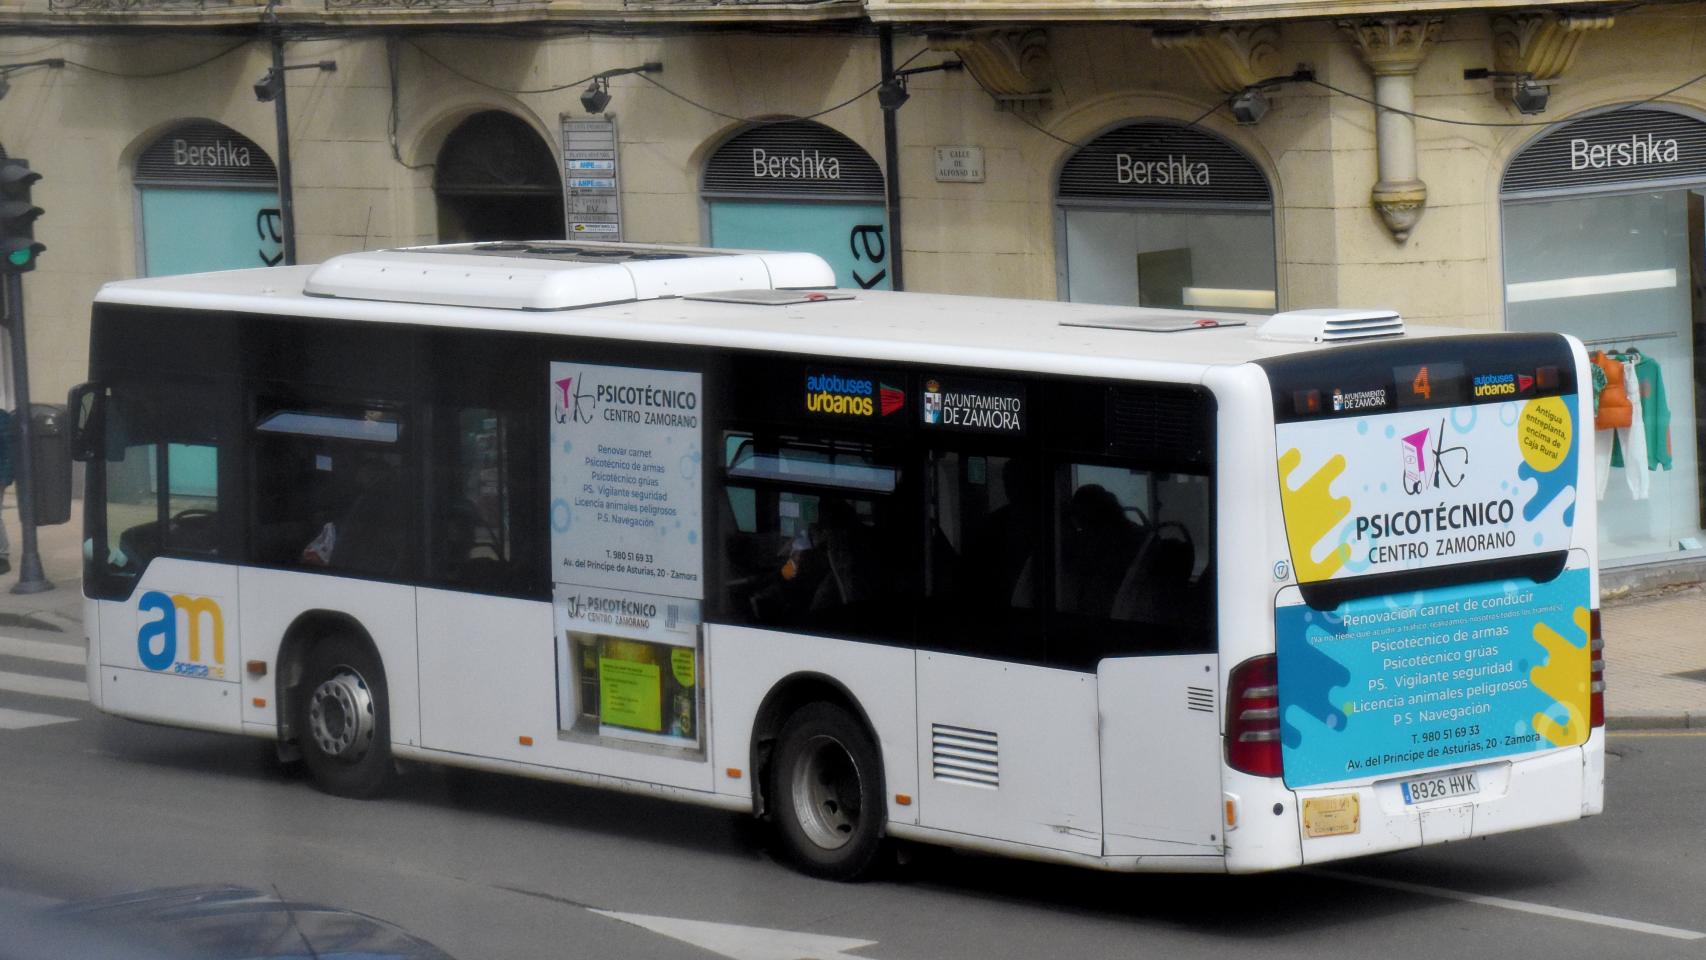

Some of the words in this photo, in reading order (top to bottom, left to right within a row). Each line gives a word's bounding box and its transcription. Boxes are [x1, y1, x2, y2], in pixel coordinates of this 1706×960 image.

[174, 139, 250, 167] Bershka
[1571, 133, 1679, 172] Bershka
[753, 148, 840, 180] Bershka
[1117, 153, 1211, 187] Bershka
[807, 374, 872, 395] autobuses
[1413, 367, 1431, 400] 4
[1474, 373, 1514, 385] autobuses
[1475, 382, 1515, 397] urbanos
[597, 384, 697, 410] PSICOTÉCNICO
[807, 391, 873, 416] urbanos
[943, 392, 1021, 412] AYUNTAMIENTO
[1344, 389, 1385, 401] AYUNTAMIENTO
[1344, 400, 1353, 409] DE
[1355, 396, 1386, 408] ZAMORA
[603, 408, 641, 424] CENTRO
[644, 411, 697, 429] ZAMORANO
[943, 407, 959, 424] DE
[962, 408, 1021, 430] ZAMORA
[1536, 405, 1563, 425] Antigua
[1524, 436, 1539, 451] Caja
[1540, 444, 1559, 459] Rural
[1526, 427, 1551, 443] encima
[1552, 438, 1561, 449] de
[597, 444, 627, 456] Renovar
[628, 448, 652, 458] carnet
[631, 461, 641, 470] de
[642, 464, 665, 473] armas
[598, 485, 630, 497] Vigilante
[631, 490, 668, 502] seguridad
[574, 496, 604, 509] Licencia
[605, 500, 638, 512] animales
[639, 503, 676, 516] peligrosos
[1356, 499, 1514, 541] PSICOTÉCNICO
[613, 551, 626, 560] 980
[627, 552, 634, 561] 51
[635, 553, 644, 561] 69
[1368, 541, 1429, 564] CENTRO
[1436, 530, 1516, 556] ZAMORANO
[563, 557, 574, 567] Av.
[575, 558, 586, 568] del
[616, 563, 626, 573] de
[657, 568, 665, 578] 20
[587, 597, 656, 617] PSICOTÉCNICO
[1420, 601, 1460, 617] carnet
[1463, 598, 1479, 612] de
[1481, 591, 1534, 609] conducir
[137, 590, 225, 672] am
[587, 612, 613, 625] CENTRO
[615, 615, 650, 629] ZAMORANO
[1453, 629, 1469, 642] de
[1471, 625, 1509, 639] armas
[1394, 670, 1449, 689] Vigilante
[1452, 659, 1513, 681] seguridad
[1353, 694, 1405, 713] Licencia
[1407, 687, 1464, 705] animales
[1466, 678, 1528, 699] peligrosos
[1422, 731, 1440, 743] 980
[1443, 729, 1453, 740] 51
[1454, 727, 1467, 738] 69
[1469, 725, 1480, 736] 33
[1347, 759, 1363, 771] Av.
[1365, 755, 1381, 767] del
[1427, 747, 1440, 758] de
[1442, 740, 1484, 755] Asturias,
[1486, 738, 1498, 749] 20
[1505, 733, 1541, 746] Zamora
[1411, 779, 1446, 800] 8926
[1449, 774, 1476, 794] HVK
